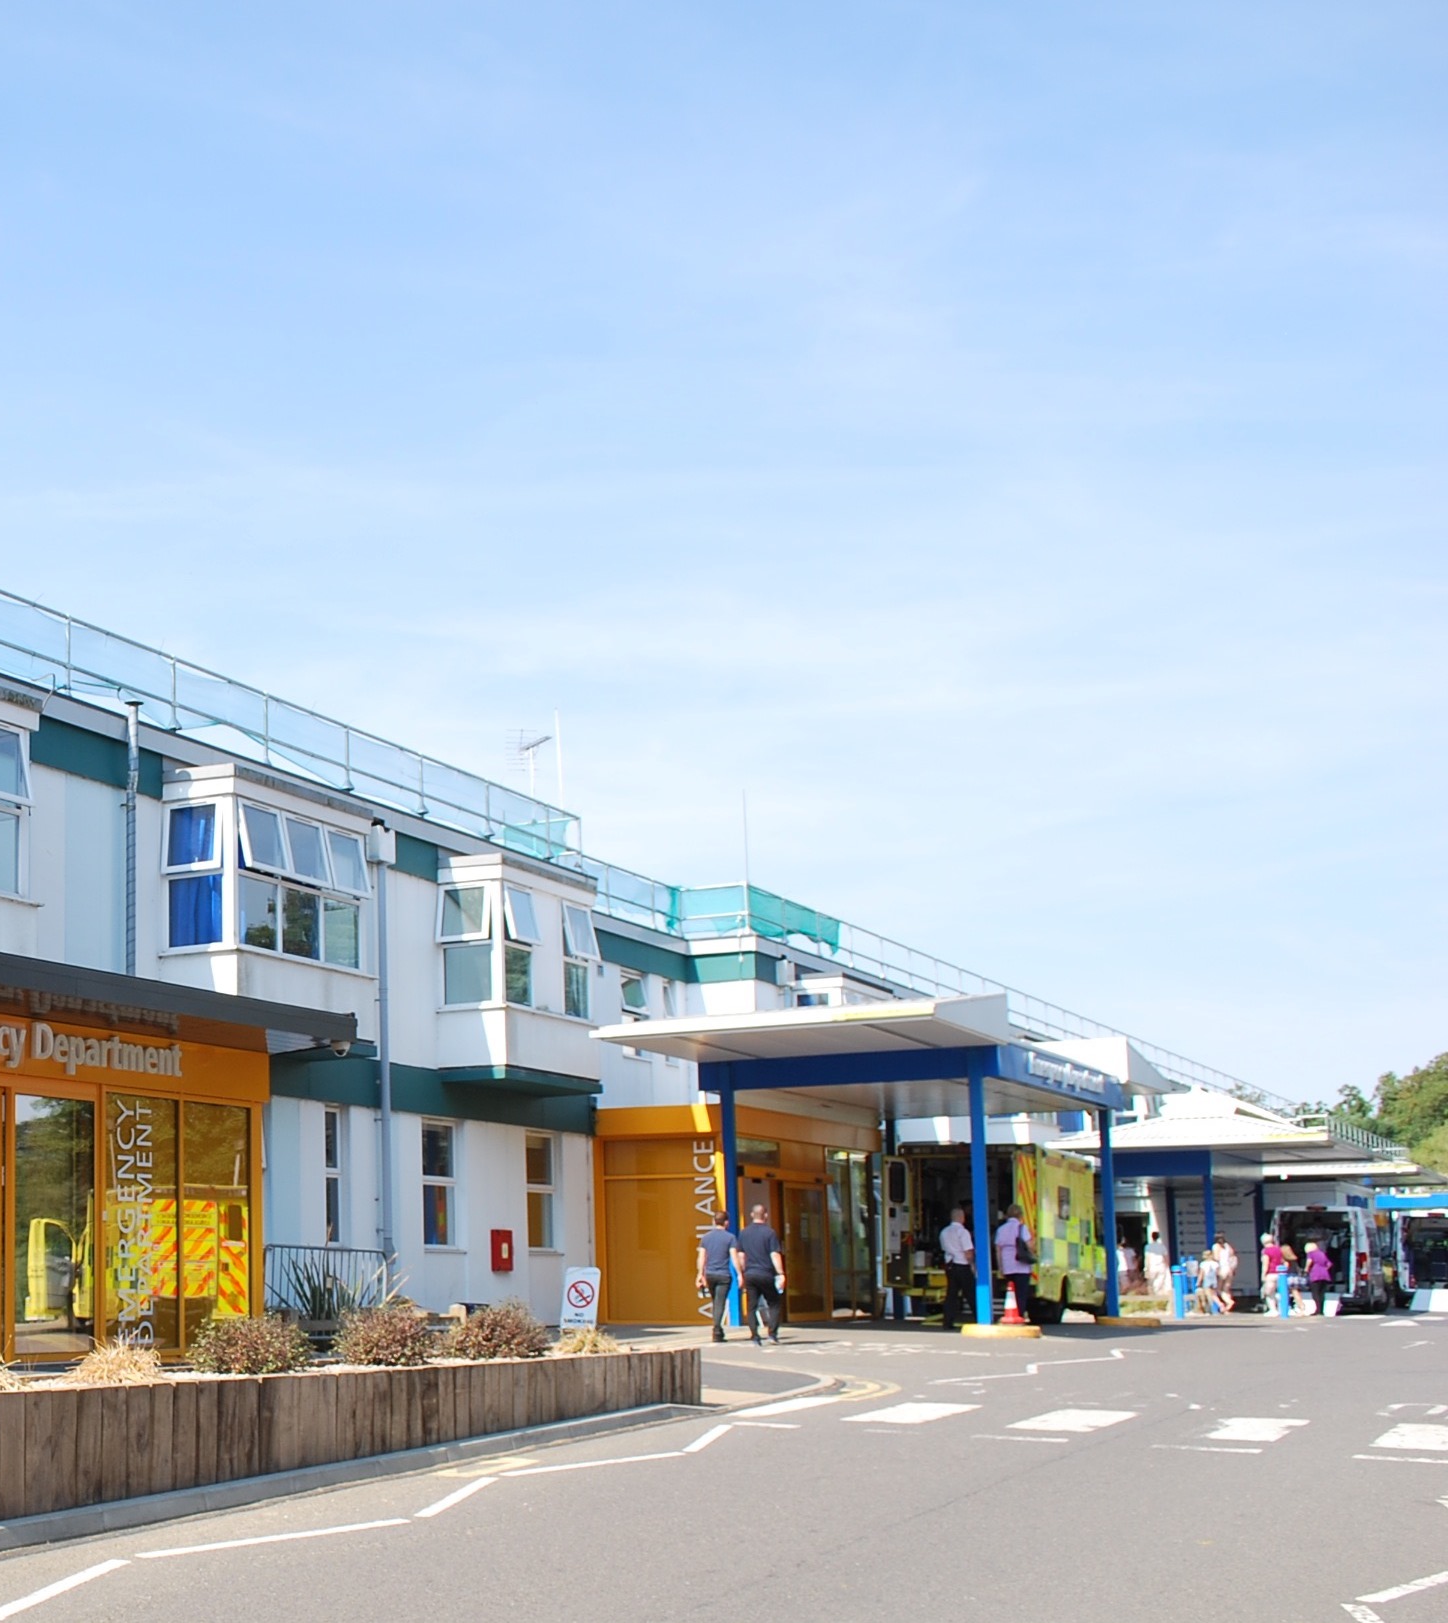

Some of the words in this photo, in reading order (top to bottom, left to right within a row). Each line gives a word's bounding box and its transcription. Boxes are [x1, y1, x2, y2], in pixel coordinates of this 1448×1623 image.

[30, 1020, 183, 1077] Department
[116, 1099, 136, 1345] EMERGENCY
[136, 1100, 154, 1345] DEPARTMENT
[692, 1139, 716, 1319] ALANCE
